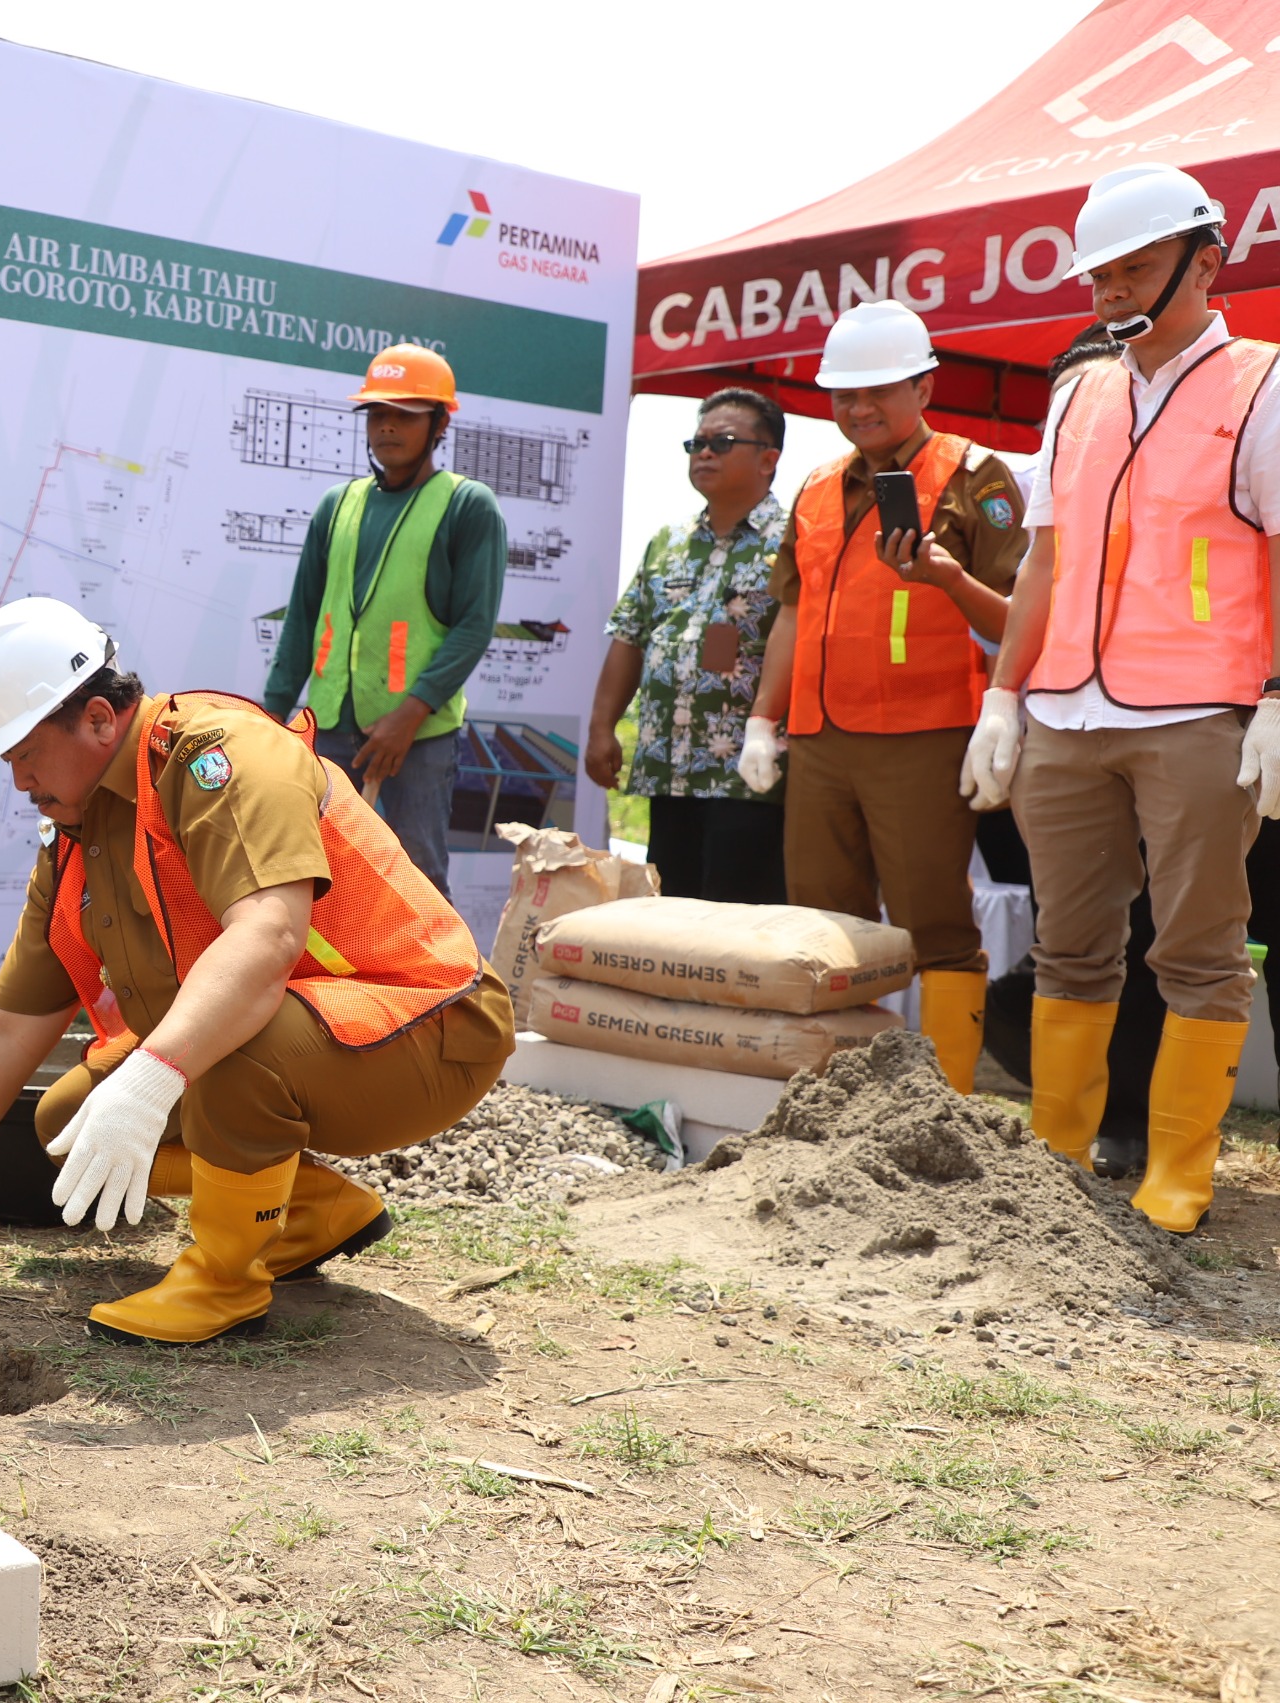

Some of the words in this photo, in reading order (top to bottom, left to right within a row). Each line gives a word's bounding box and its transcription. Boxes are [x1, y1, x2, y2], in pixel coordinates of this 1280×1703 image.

[499, 223, 600, 263] PERTAMINA
[4, 232, 62, 268] AIR
[69, 242, 192, 292] LIMBAH
[197, 267, 278, 306] TAHU
[498, 251, 528, 272] GAS
[531, 259, 589, 284] NEGARA
[143, 288, 317, 346] KABUPATEN
[649, 247, 946, 352] CABANG
[190, 731, 221, 749] JOMBANG
[592, 951, 655, 973] GRESIK
[662, 961, 726, 983] SEMEN
[587, 1012, 649, 1036] SEMEN
[655, 1025, 725, 1048] GRESIK
